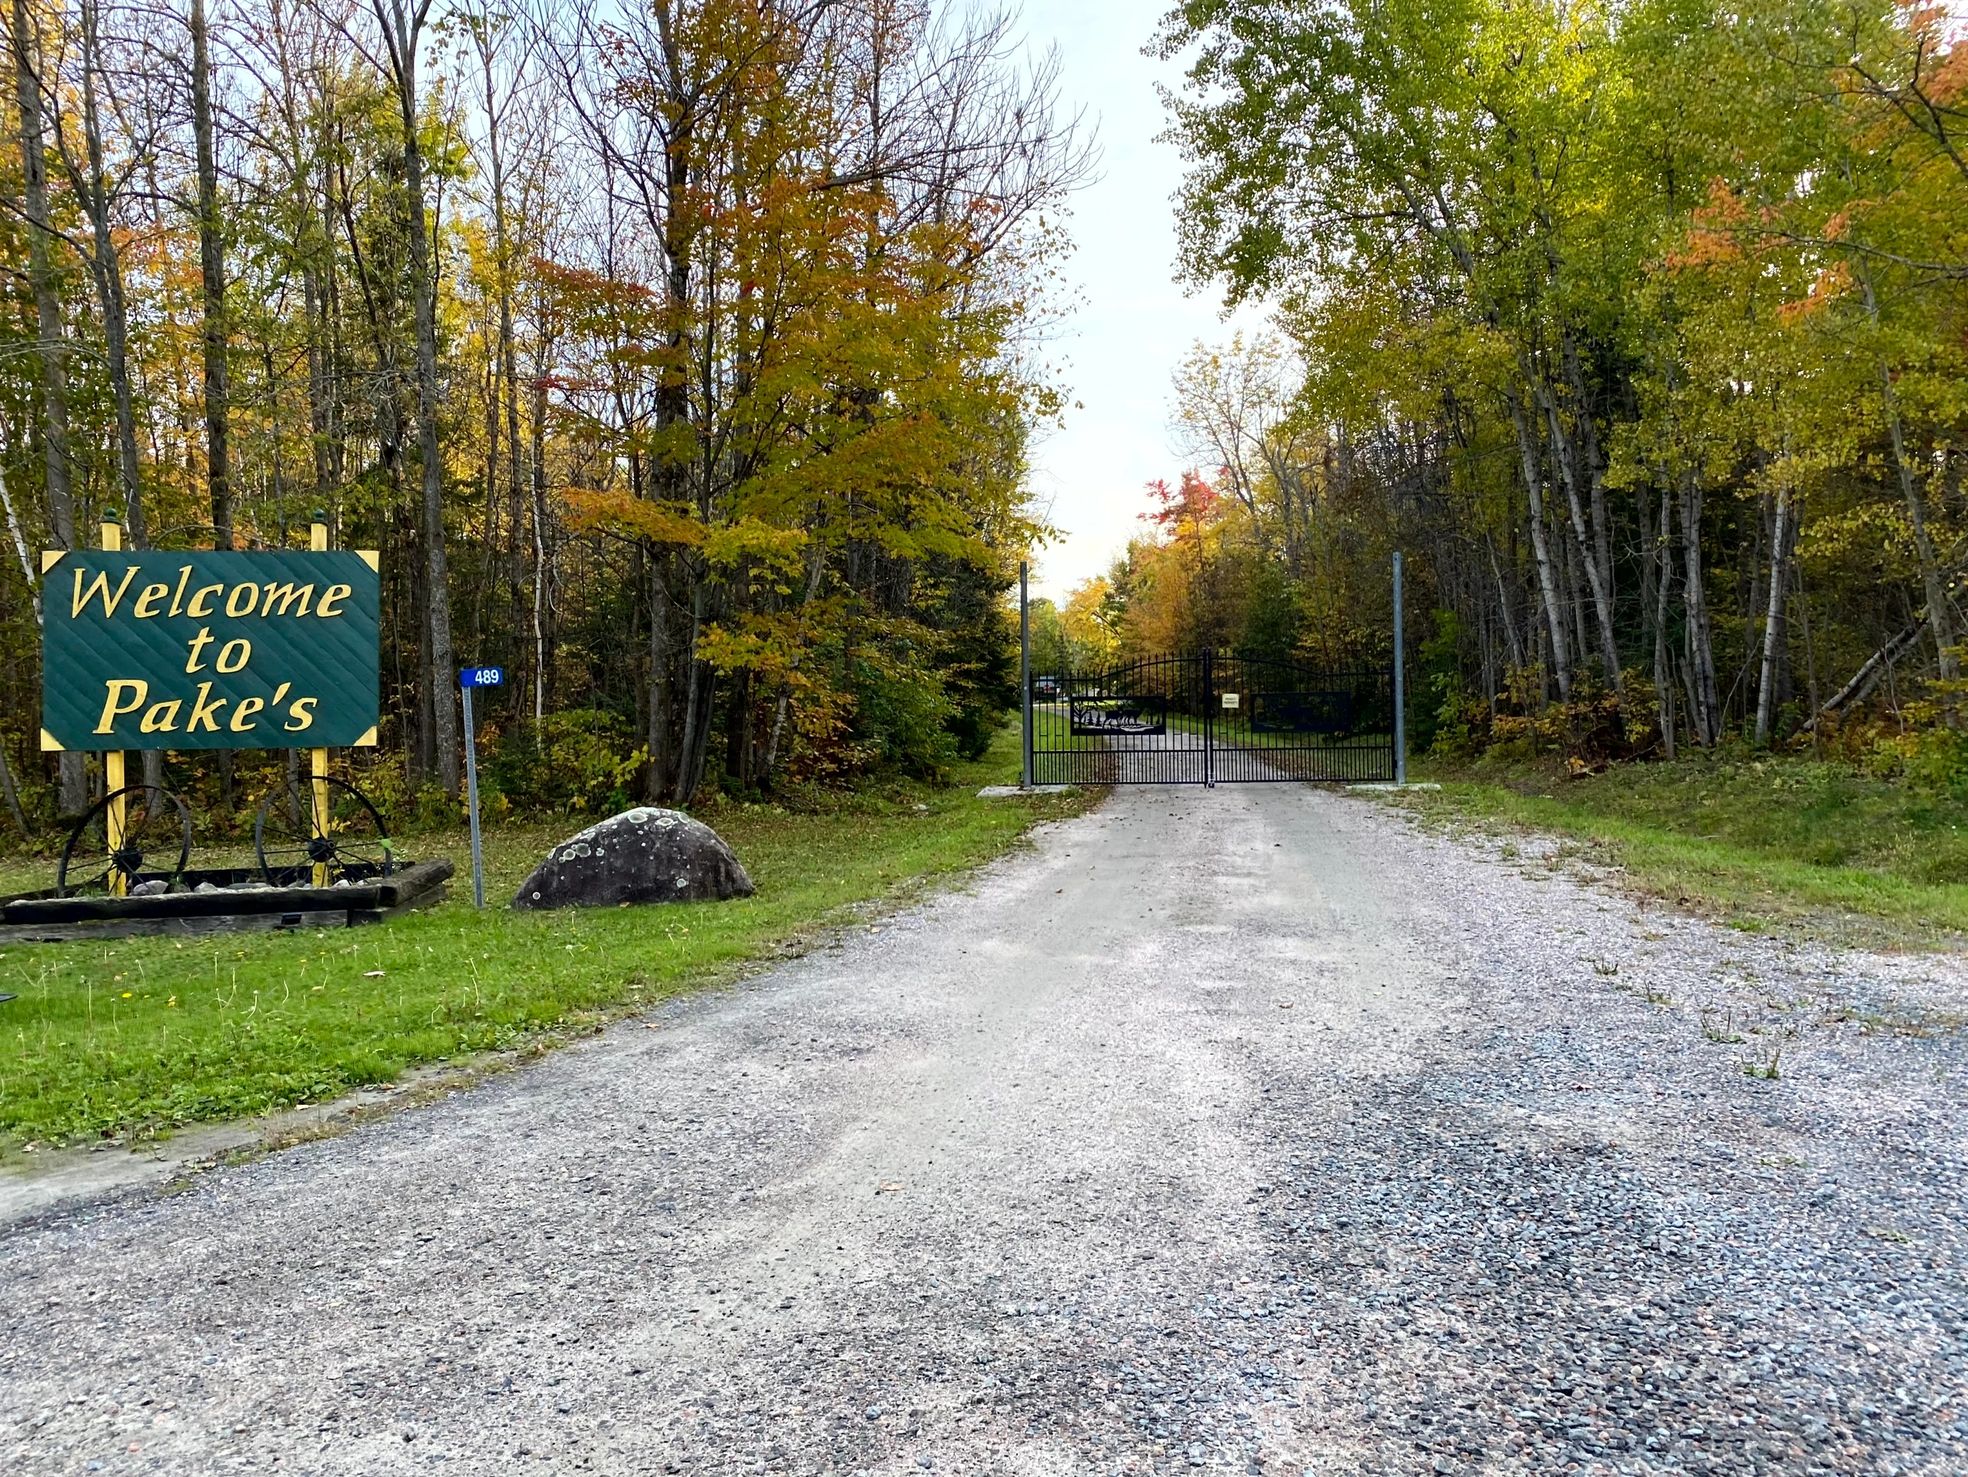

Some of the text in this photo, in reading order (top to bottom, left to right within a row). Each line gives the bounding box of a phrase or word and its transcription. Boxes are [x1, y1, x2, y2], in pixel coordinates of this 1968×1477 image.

[71, 565, 352, 619] Welcome
[185, 626, 252, 674] to
[474, 669, 500, 685] 489
[92, 679, 319, 735] Pake's
